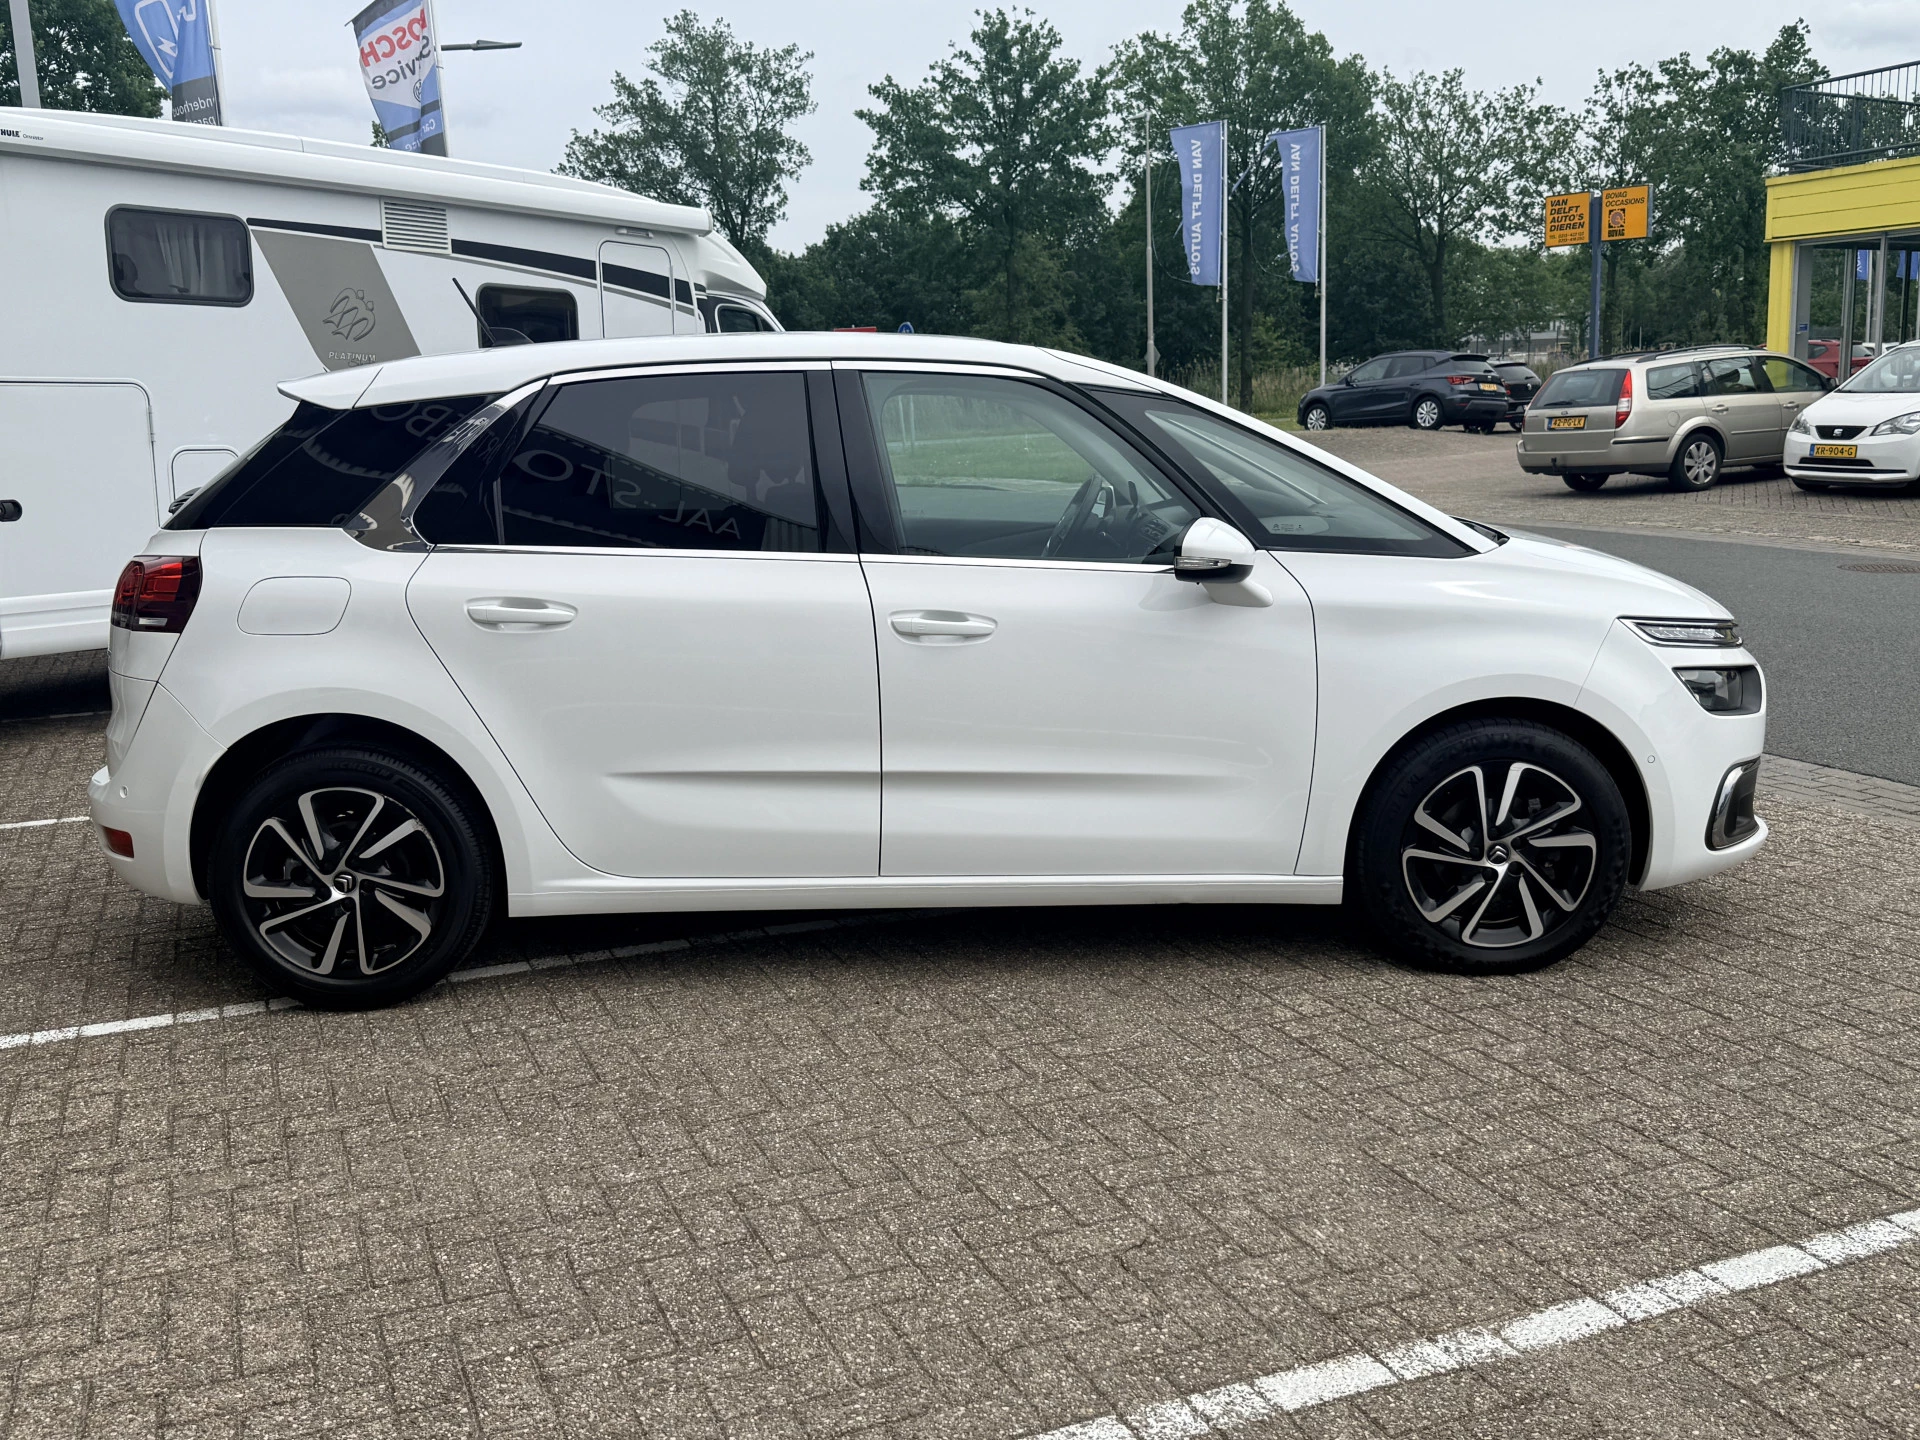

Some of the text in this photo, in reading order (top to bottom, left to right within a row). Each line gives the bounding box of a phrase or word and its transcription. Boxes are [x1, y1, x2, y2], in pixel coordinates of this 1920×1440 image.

[0, 128, 21, 138] HULE
[1605, 191, 1627, 200] BOVAG
[1550, 198, 1568, 207] VAN
[1605, 197, 1645, 207] OCCASIONS
[1550, 205, 1580, 215] DELFT
[1550, 213, 1584, 224] AUTO'S
[1549, 221, 1585, 232] DIEREN
[328, 351, 376, 361] PLATINUM
[1553, 417, 1583, 427] 42-PG-LK
[1815, 446, 1853, 456] XR-904-G
